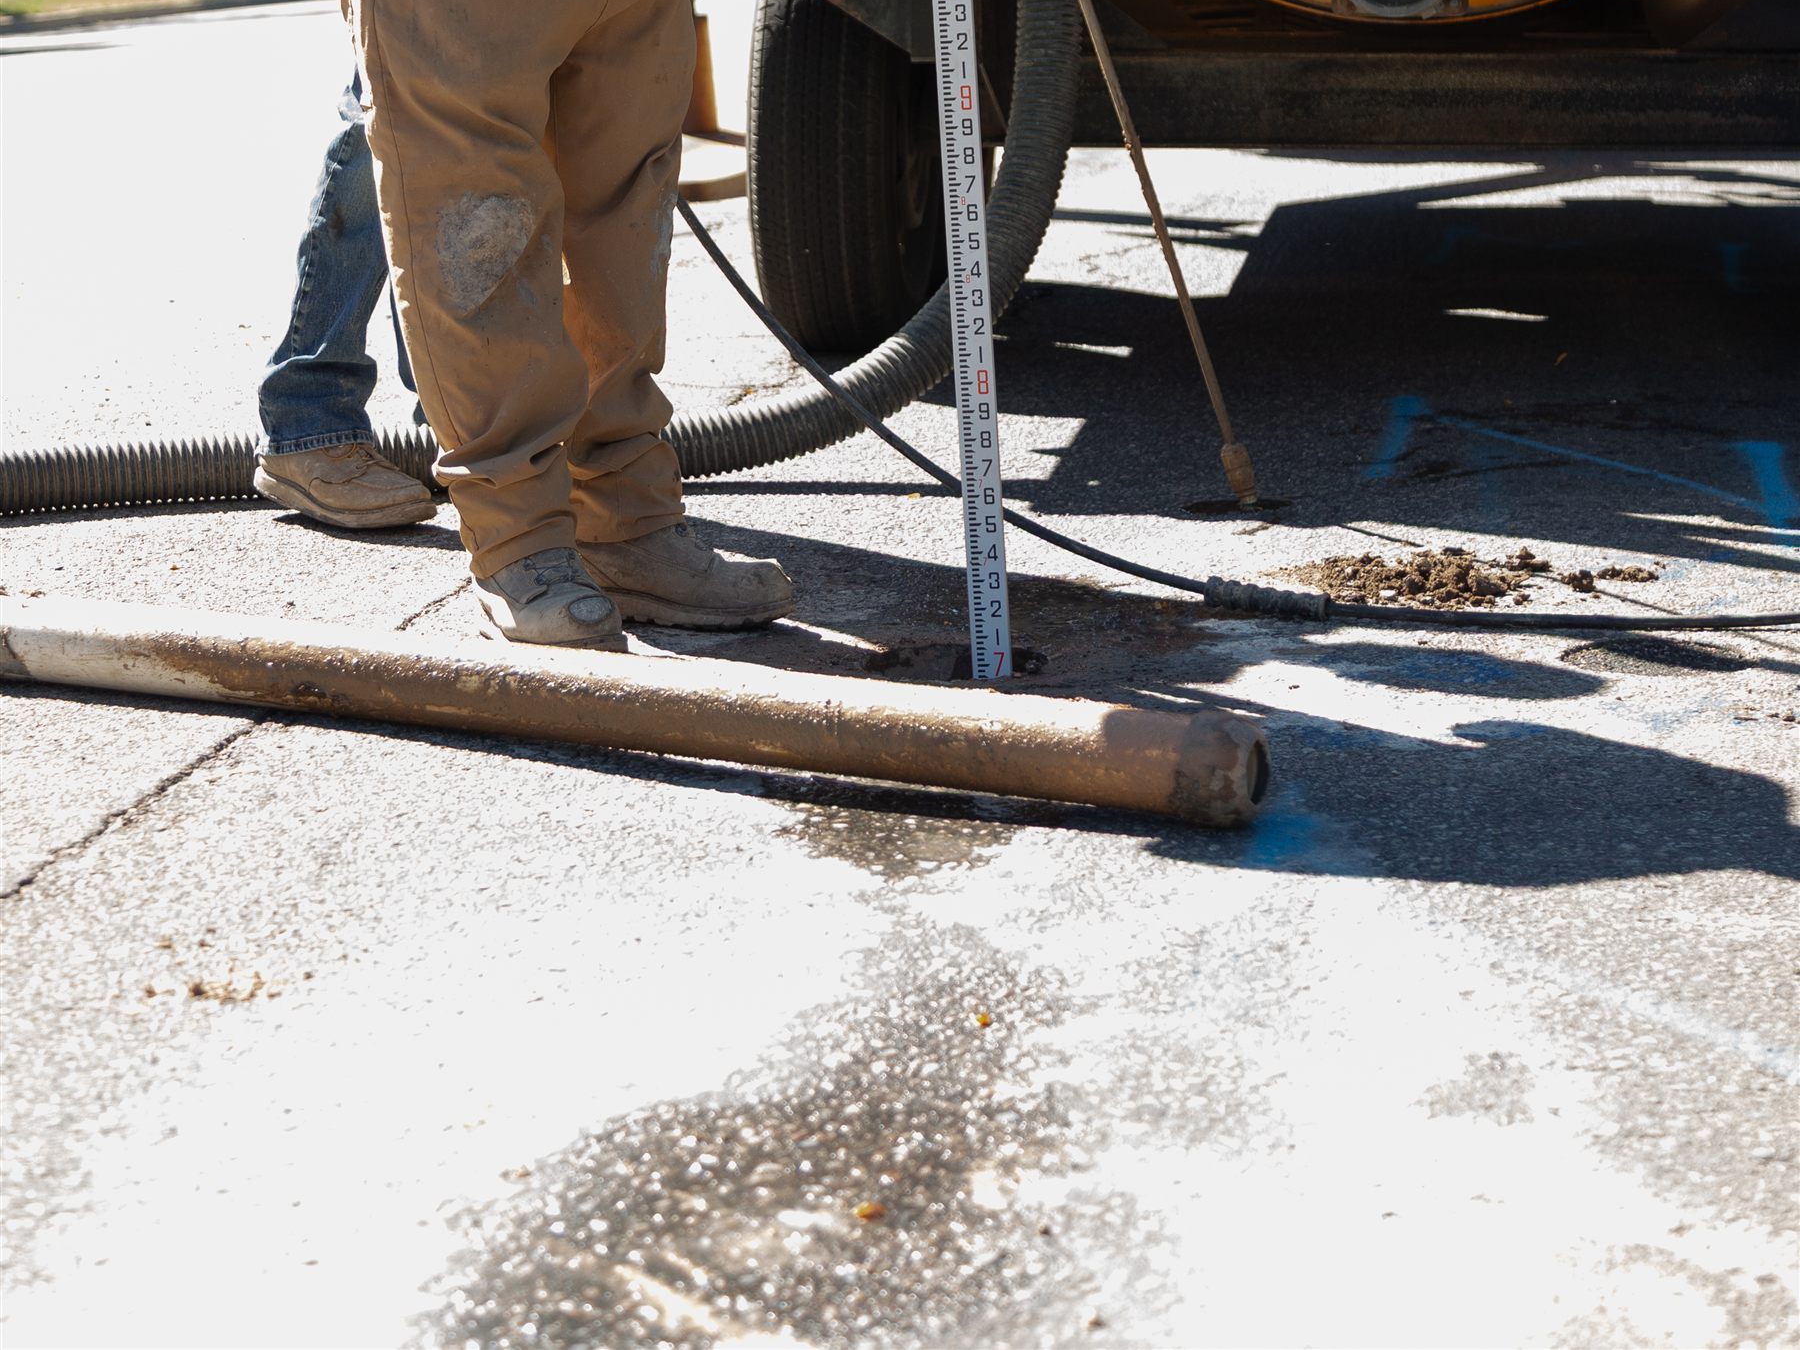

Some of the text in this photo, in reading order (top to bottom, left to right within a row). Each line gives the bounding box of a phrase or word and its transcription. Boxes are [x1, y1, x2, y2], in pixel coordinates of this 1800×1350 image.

[955, 3, 967, 22] 3
[957, 32, 969, 51] 2
[960, 84, 973, 112] 9
[962, 118, 974, 137] 9
[963, 146, 976, 165] 8
[965, 175, 976, 194] 7
[967, 203, 979, 222] 6
[968, 232, 980, 251] 5
[970, 260, 982, 279] 4
[972, 288, 984, 307] 3
[973, 317, 986, 336] 2
[976, 368, 990, 396] 8
[978, 402, 991, 421] 9
[980, 430, 992, 449] 8
[981, 458, 993, 477] 7
[983, 487, 996, 506] 6
[985, 515, 997, 534] 5
[987, 543, 999, 562] 4
[988, 571, 1001, 590] 3
[990, 599, 1003, 618] 2
[993, 651, 1005, 677] 7
